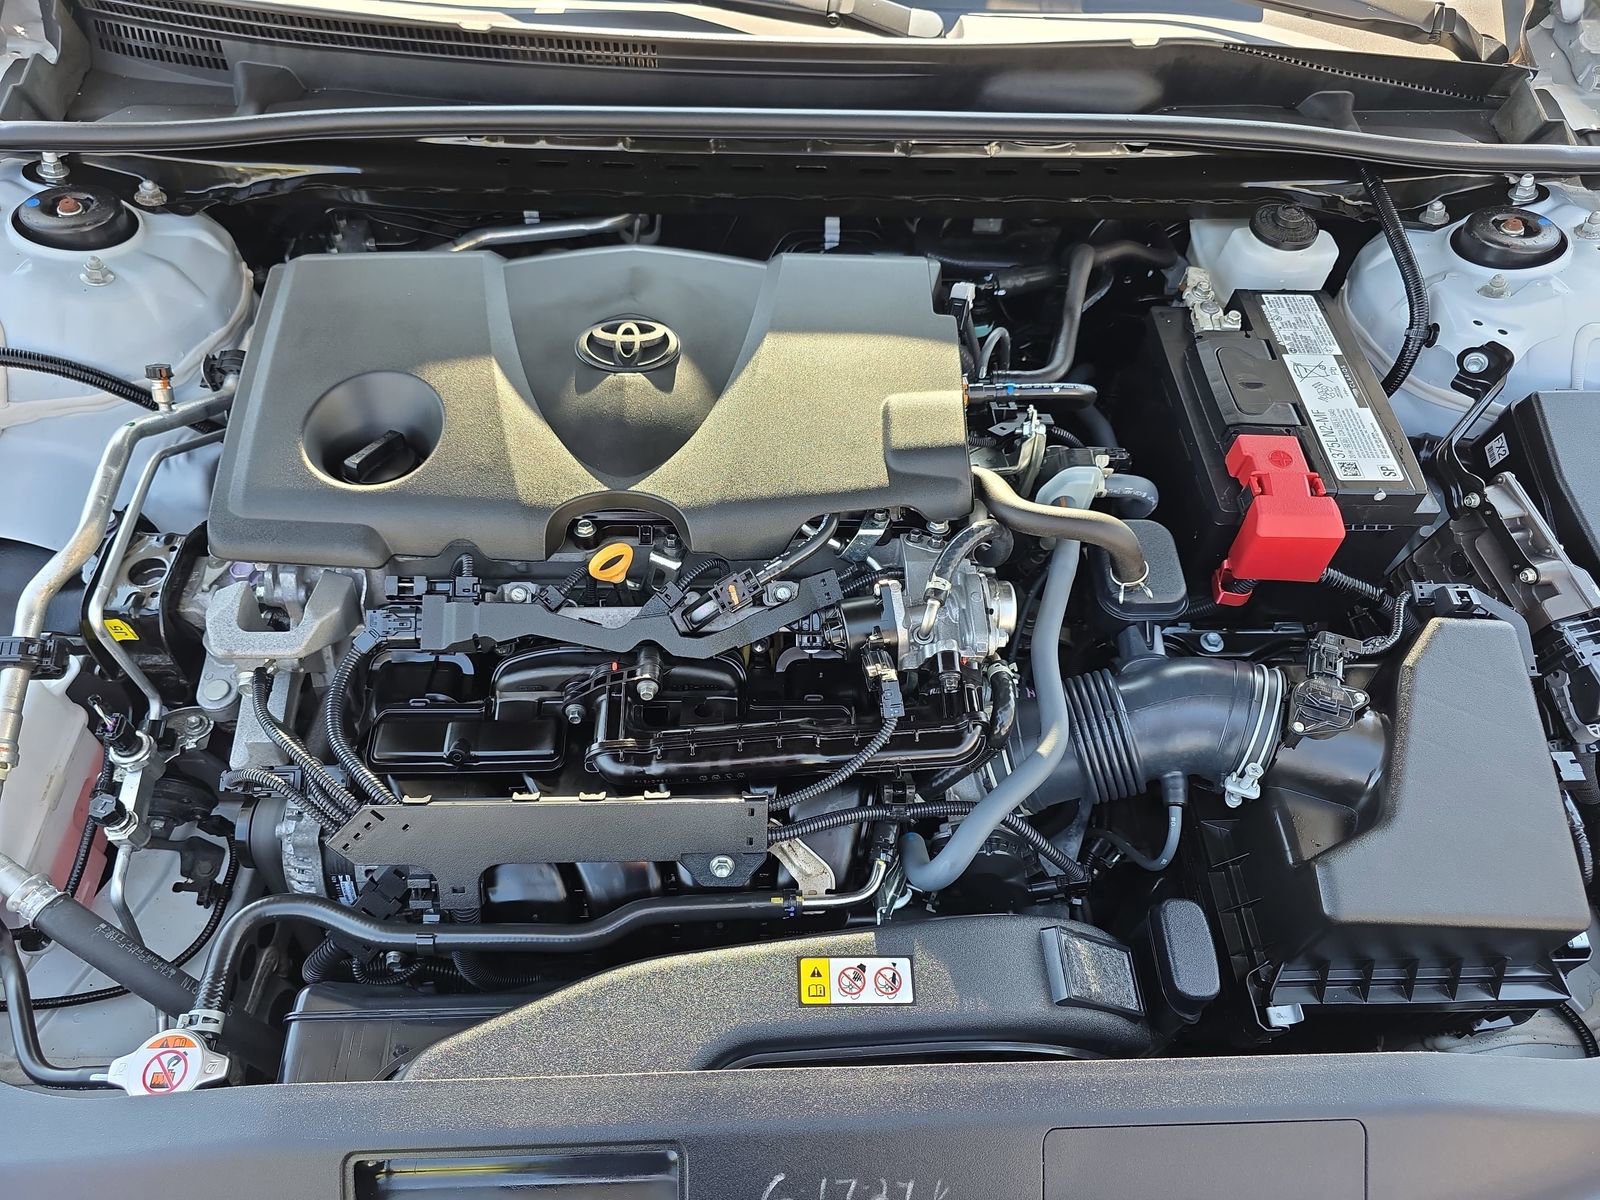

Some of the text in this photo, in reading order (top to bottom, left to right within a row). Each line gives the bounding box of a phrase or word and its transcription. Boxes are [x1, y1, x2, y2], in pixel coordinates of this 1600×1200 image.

[1311, 409, 1346, 459] 375LN2-MF
[1494, 436, 1507, 459] FX2
[1380, 466, 1397, 477] SP
[109, 625, 128, 636] J5
